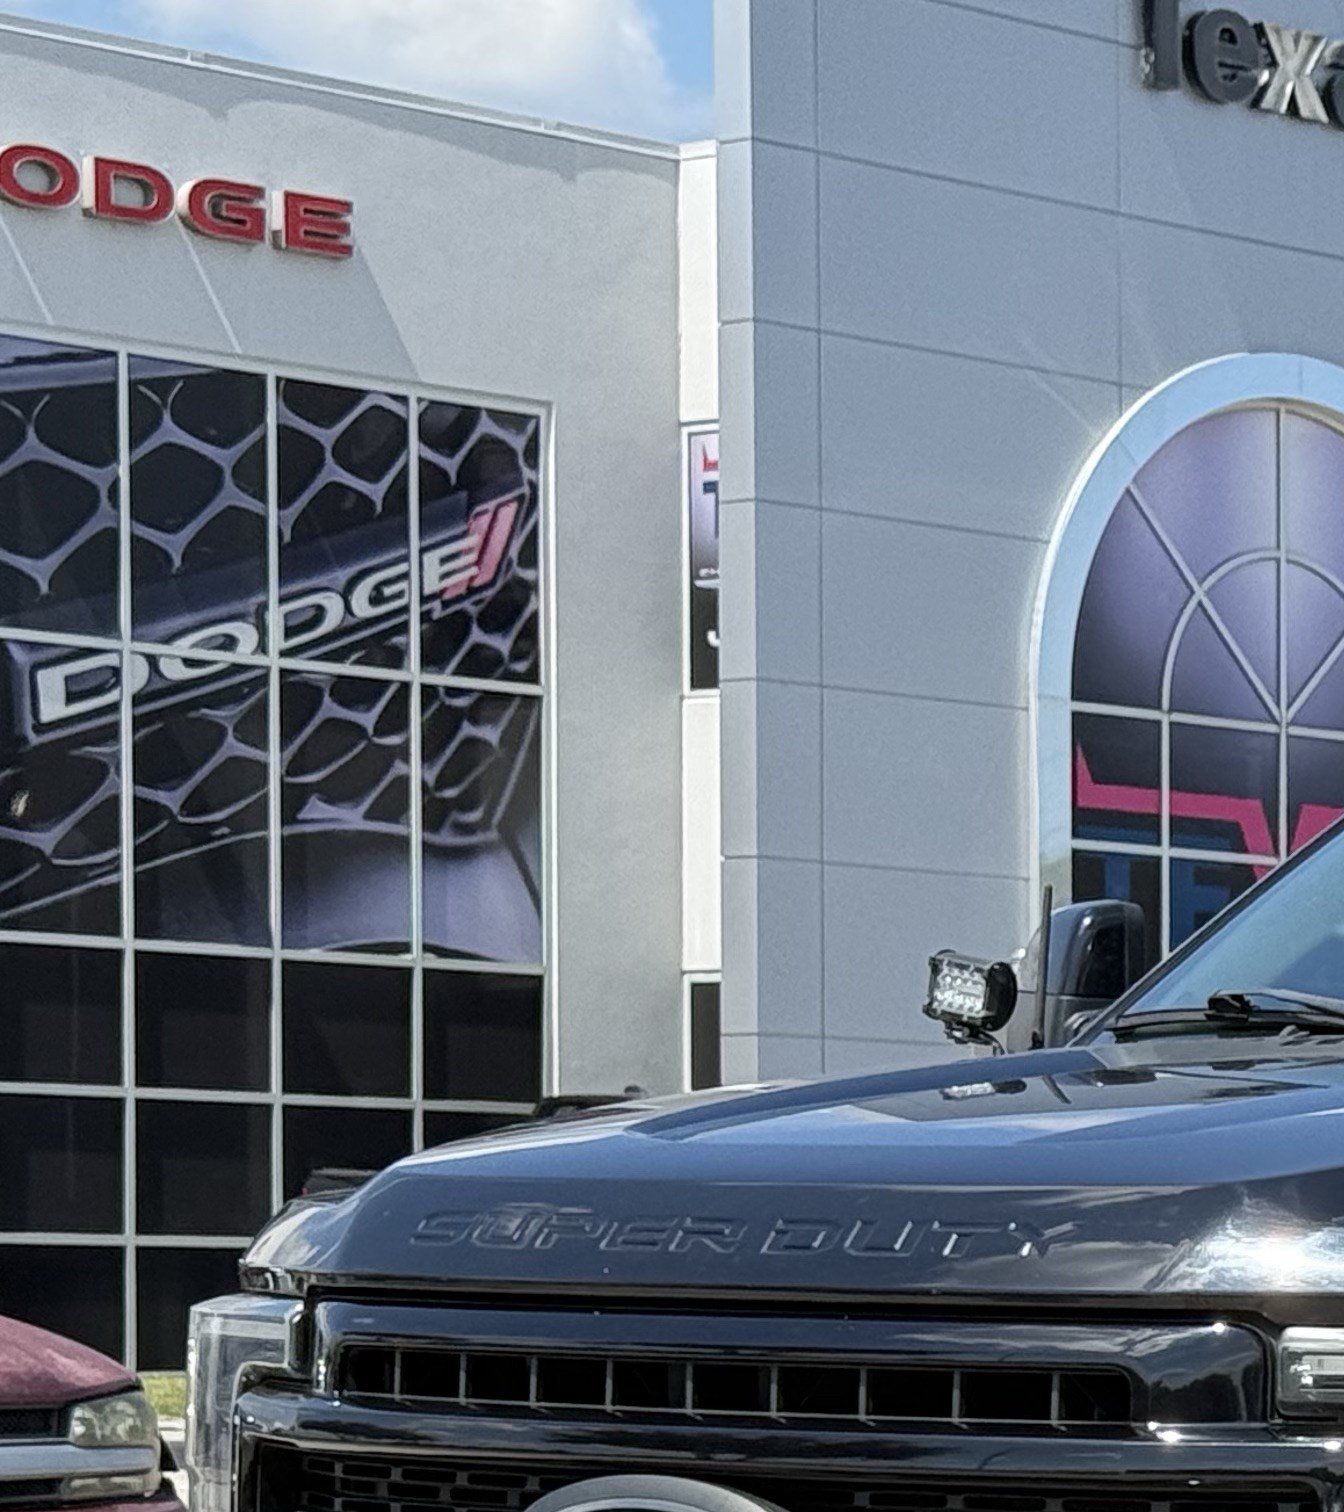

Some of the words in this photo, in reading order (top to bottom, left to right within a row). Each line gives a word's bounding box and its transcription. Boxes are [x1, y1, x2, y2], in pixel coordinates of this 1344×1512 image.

[0, 141, 355, 258] ODGE
[37, 534, 482, 724] DODGE
[410, 1202, 748, 1255] SUPER
[761, 1215, 1082, 1259] DUTY
